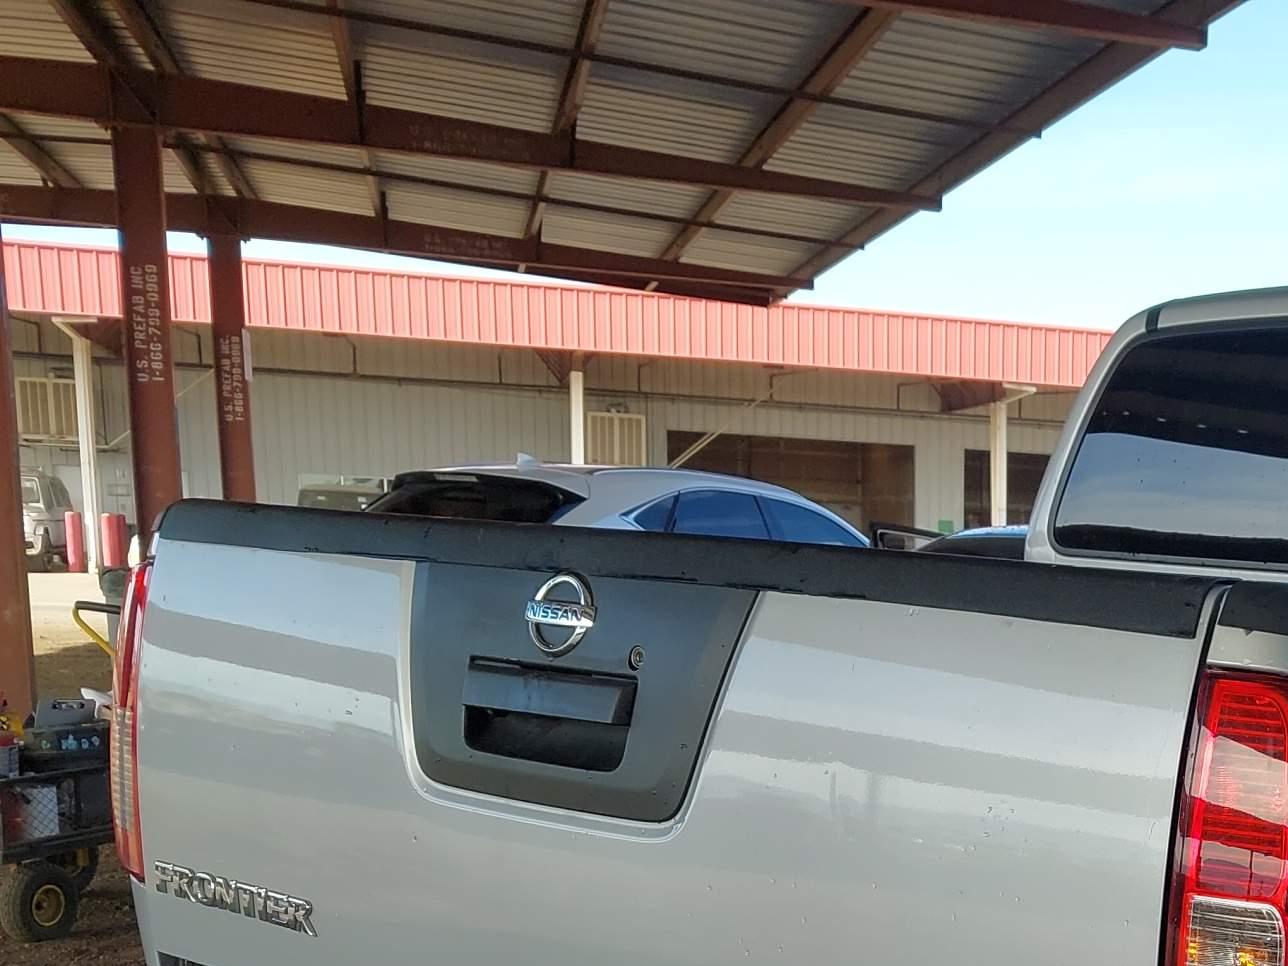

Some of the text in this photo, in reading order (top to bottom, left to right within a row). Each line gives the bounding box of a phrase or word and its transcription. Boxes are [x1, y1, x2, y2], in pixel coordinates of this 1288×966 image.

[132, 295, 147, 349] PREFAB
[145, 264, 165, 382] 1-866-799-0969
[136, 356, 149, 382] U.S.
[221, 359, 233, 397] PREFAB
[529, 602, 585, 621] NISSAN
[154, 860, 318, 937] FRONTIER
